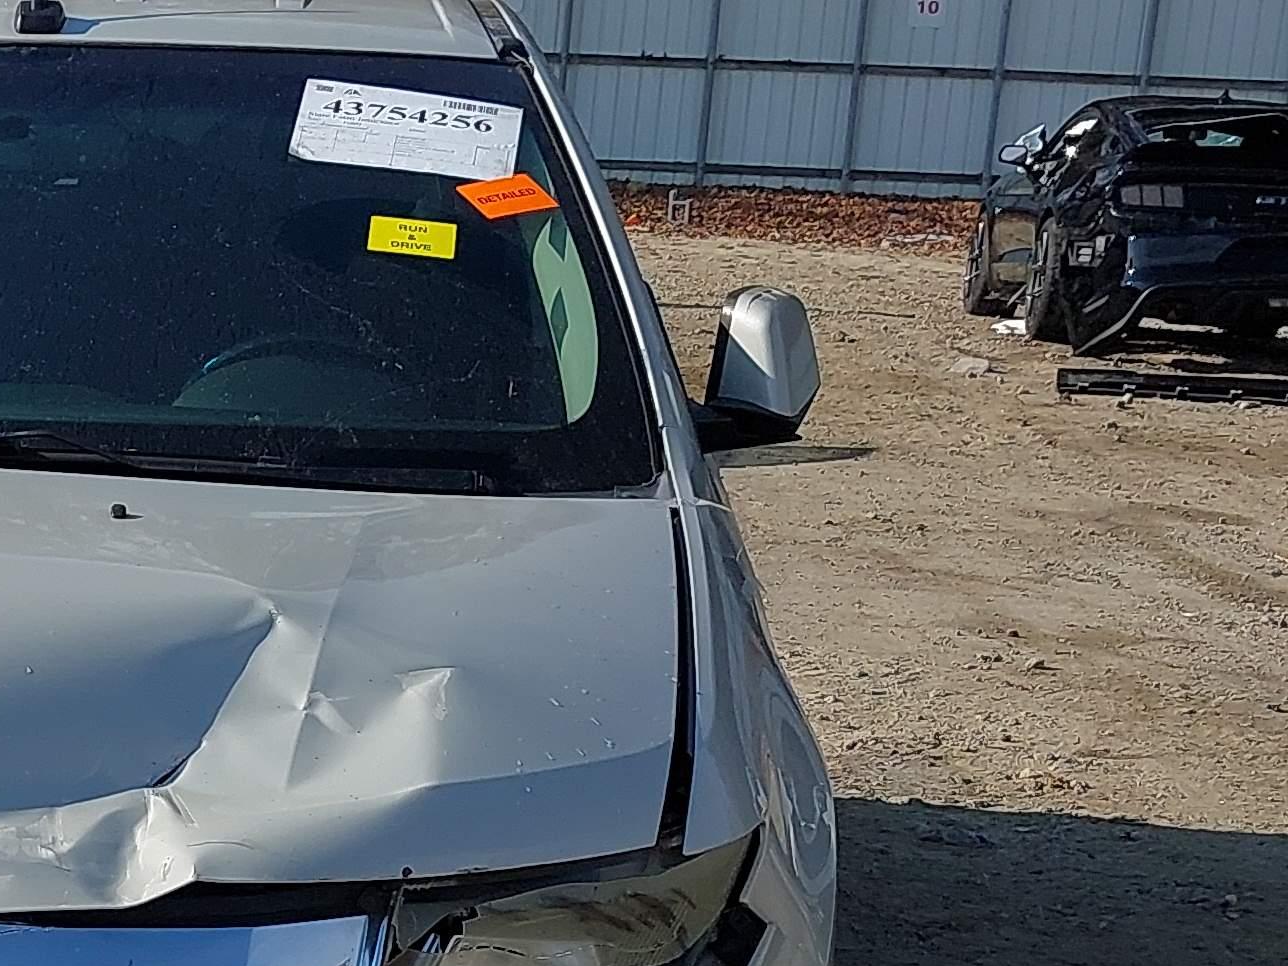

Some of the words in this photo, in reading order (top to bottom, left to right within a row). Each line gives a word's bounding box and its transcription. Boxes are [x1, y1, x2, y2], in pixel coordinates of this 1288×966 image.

[917, 0, 940, 15] 10
[321, 99, 493, 133] 43754256
[476, 187, 537, 205] DETAILED
[398, 223, 429, 234] RUN
[390, 240, 432, 252] DRIVE
